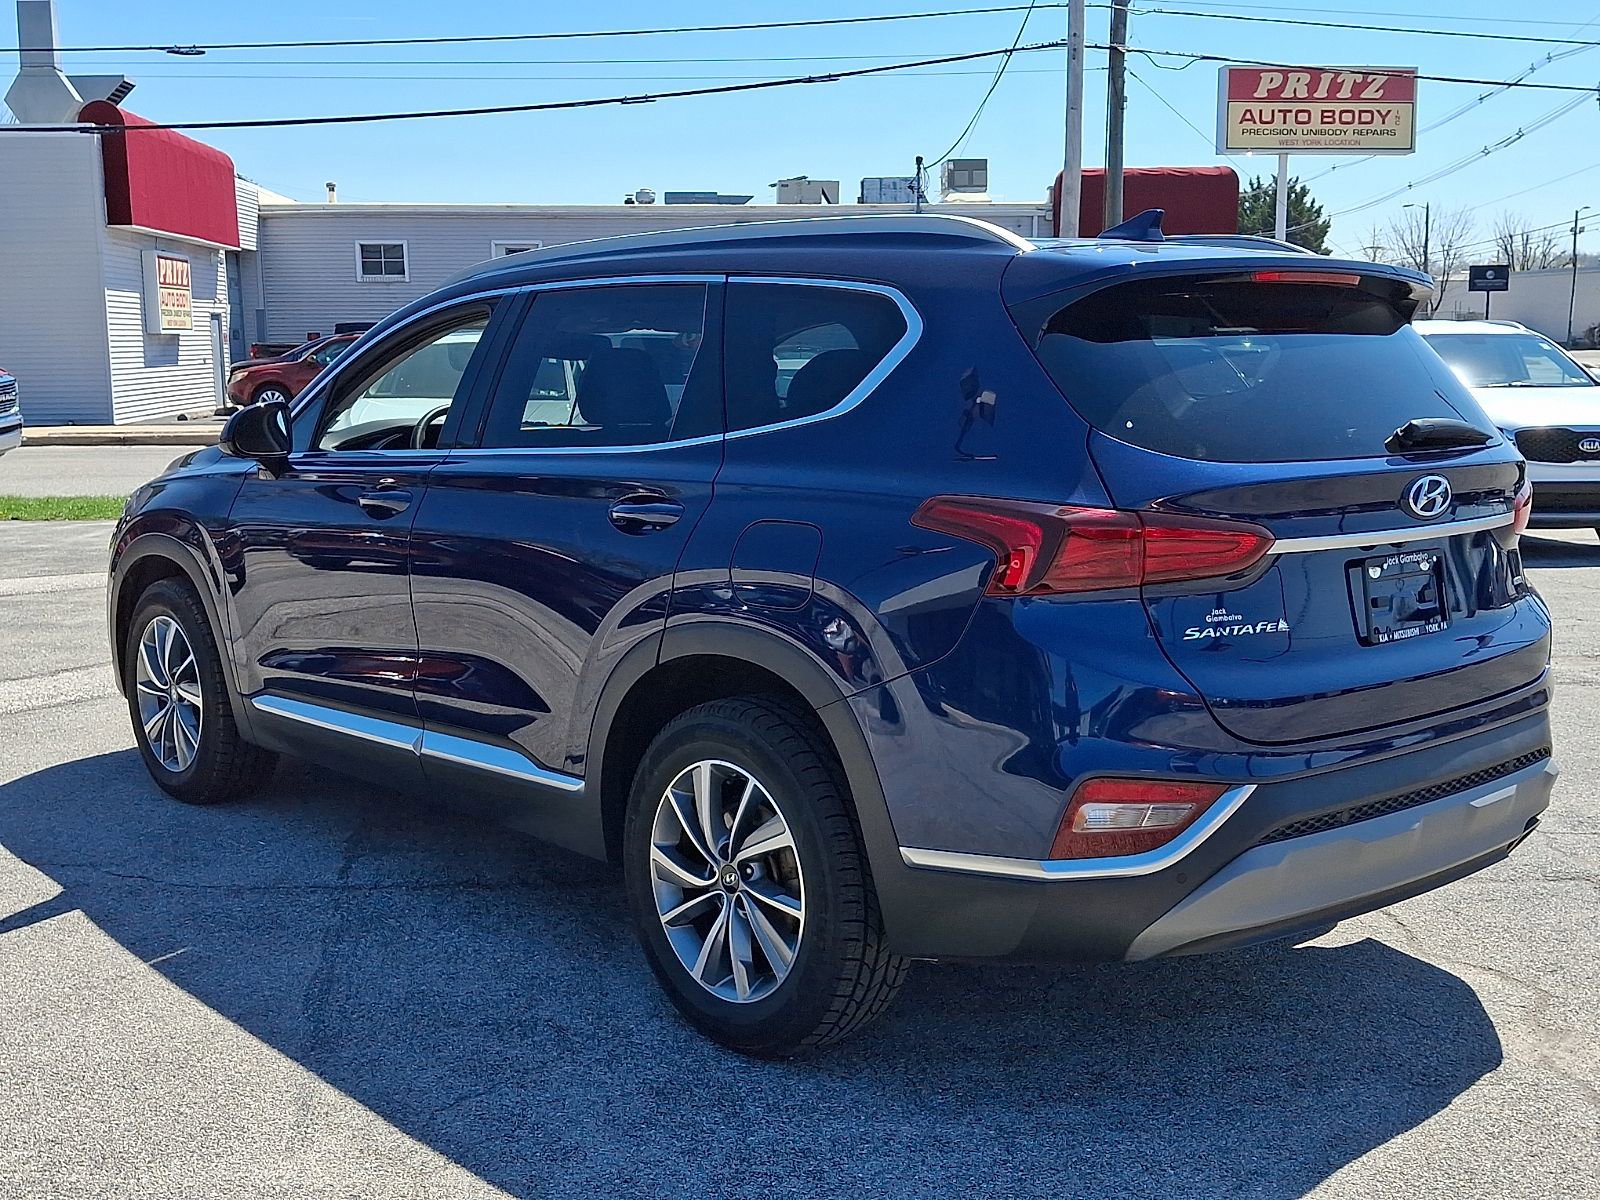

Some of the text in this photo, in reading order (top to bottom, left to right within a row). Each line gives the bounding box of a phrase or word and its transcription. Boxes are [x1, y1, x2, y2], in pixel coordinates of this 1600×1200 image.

[1253, 72, 1389, 99] PRITZ
[1239, 109, 1392, 125] AUTO BODY
[1241, 128, 1397, 137] PRECISION UNIBODY REPAIRS
[160, 258, 188, 285] PRITZ
